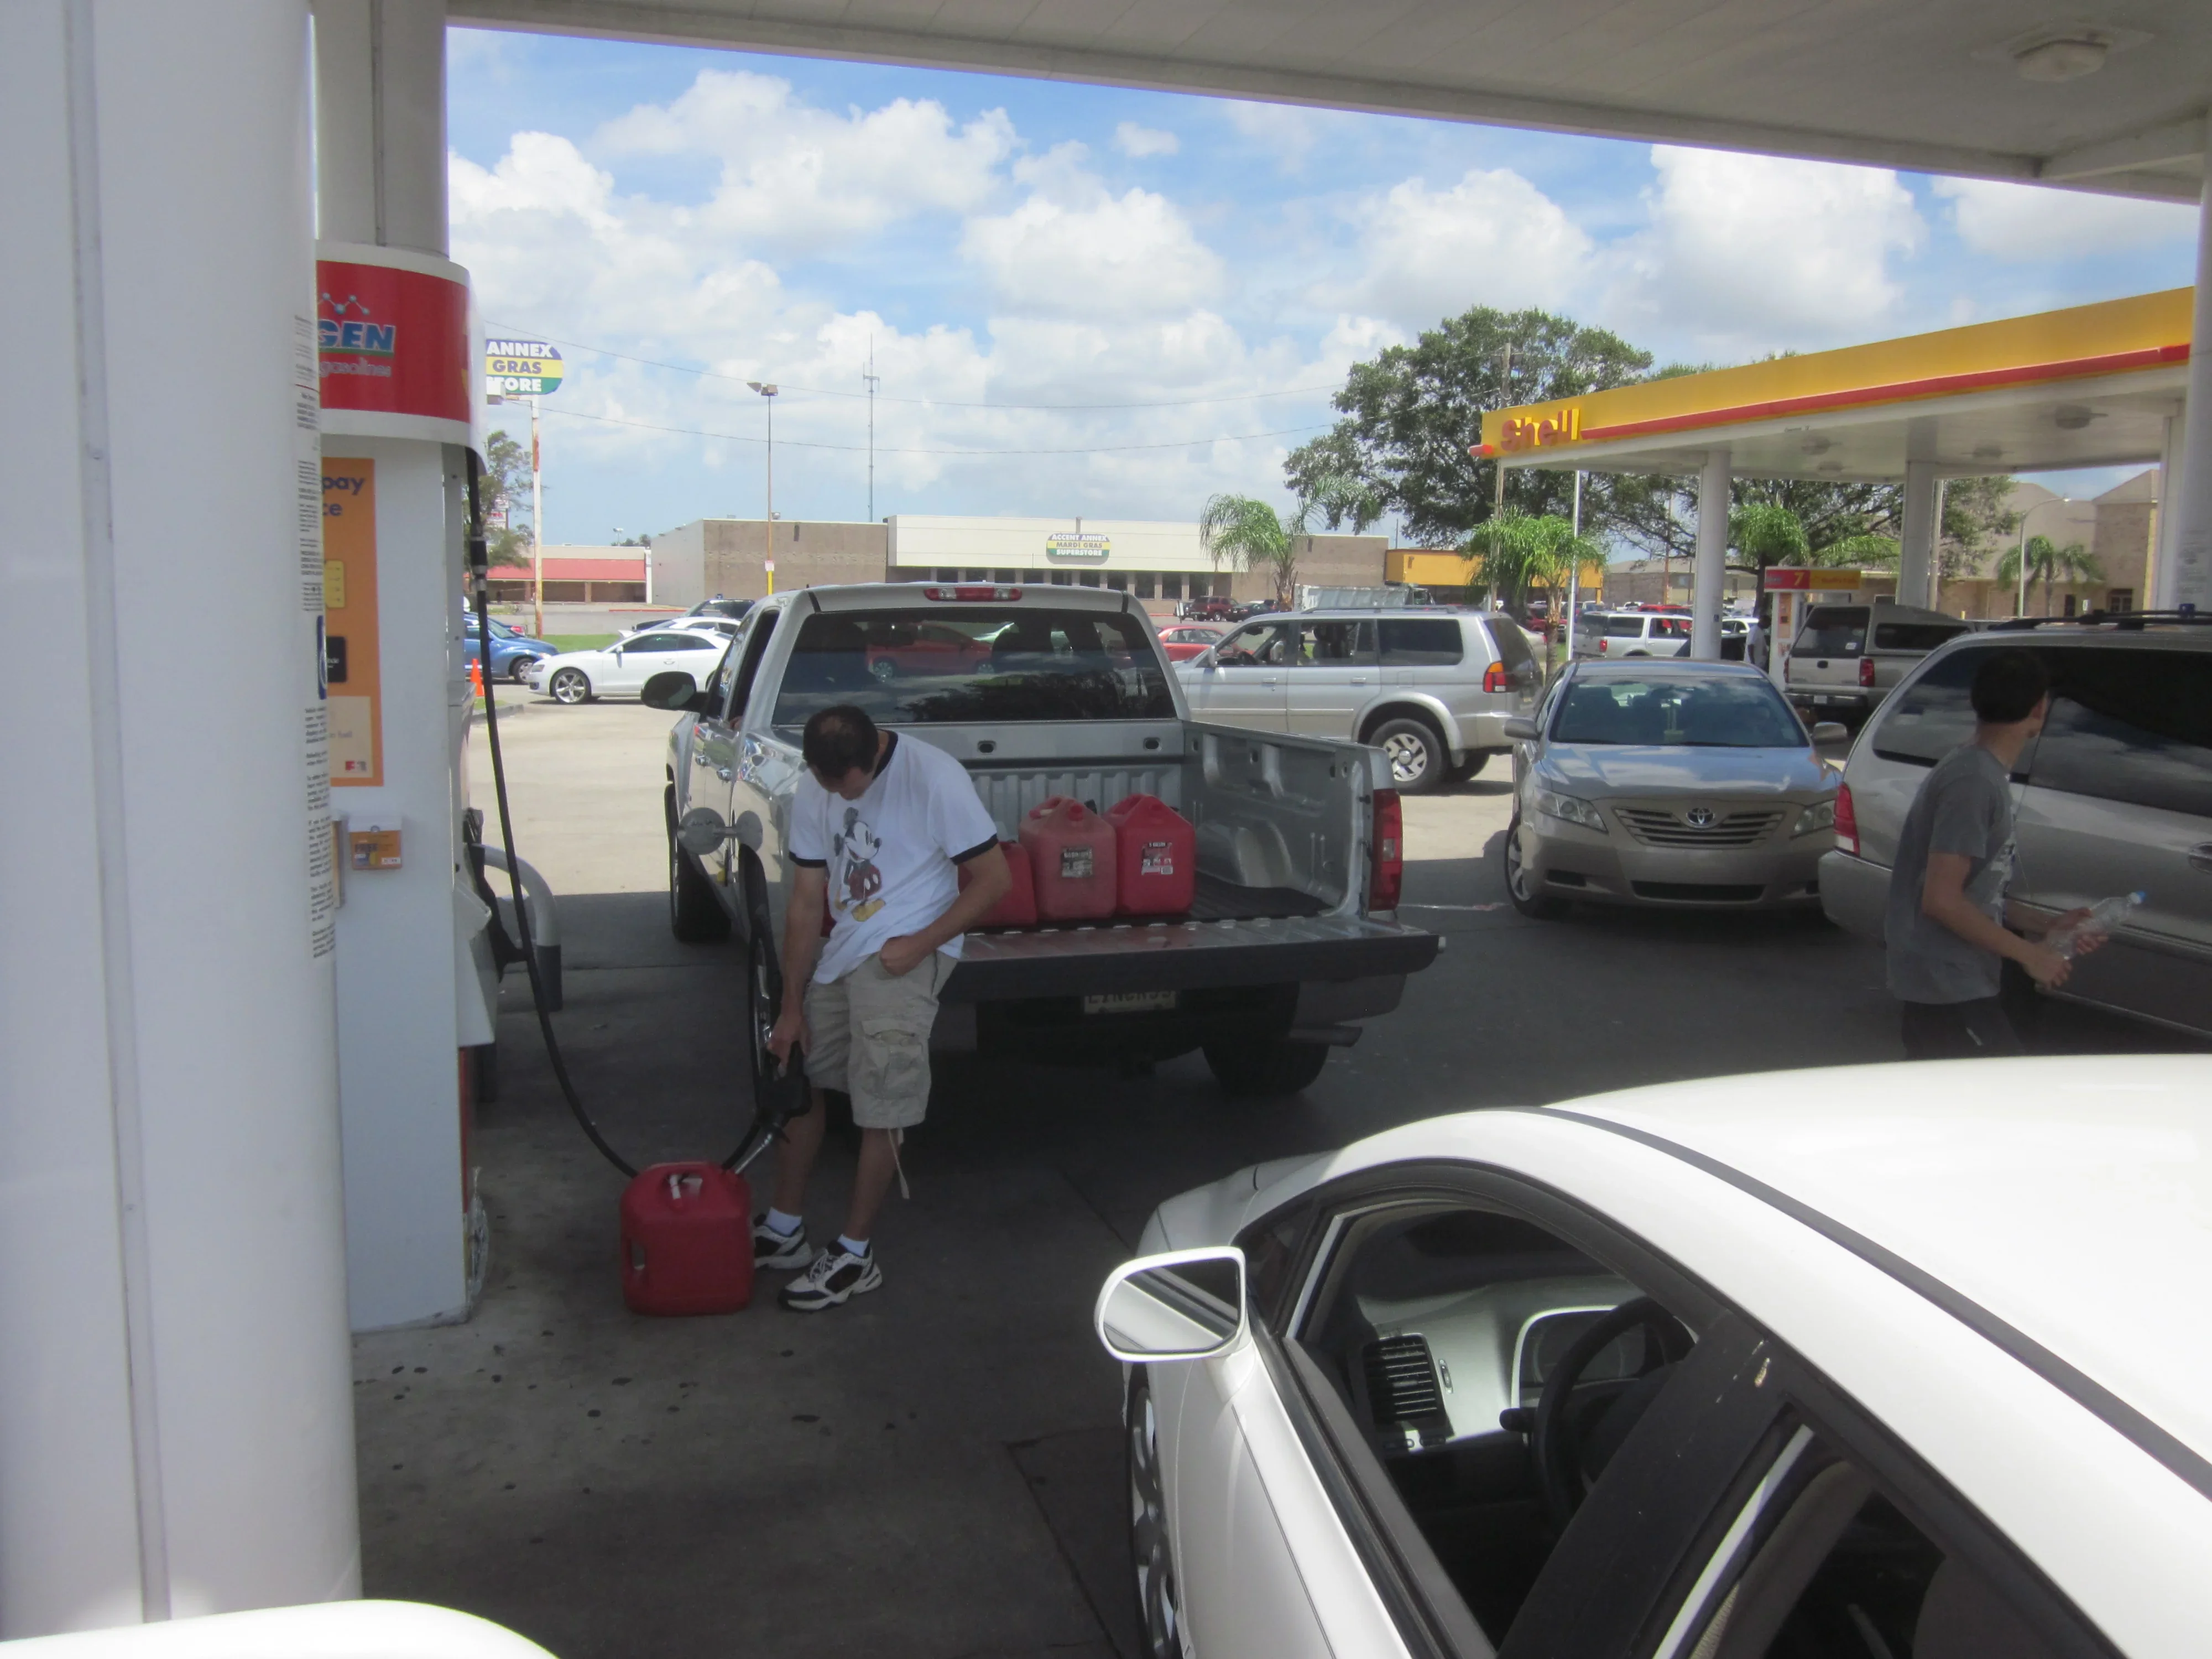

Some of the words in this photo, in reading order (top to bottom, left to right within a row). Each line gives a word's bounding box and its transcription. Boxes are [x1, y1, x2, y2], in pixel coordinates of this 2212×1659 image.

[486, 341, 553, 358] ANNEX
[492, 359, 542, 374] GRAS
[1500, 409, 1579, 451] Shell
[1794, 572, 1804, 586] 7
